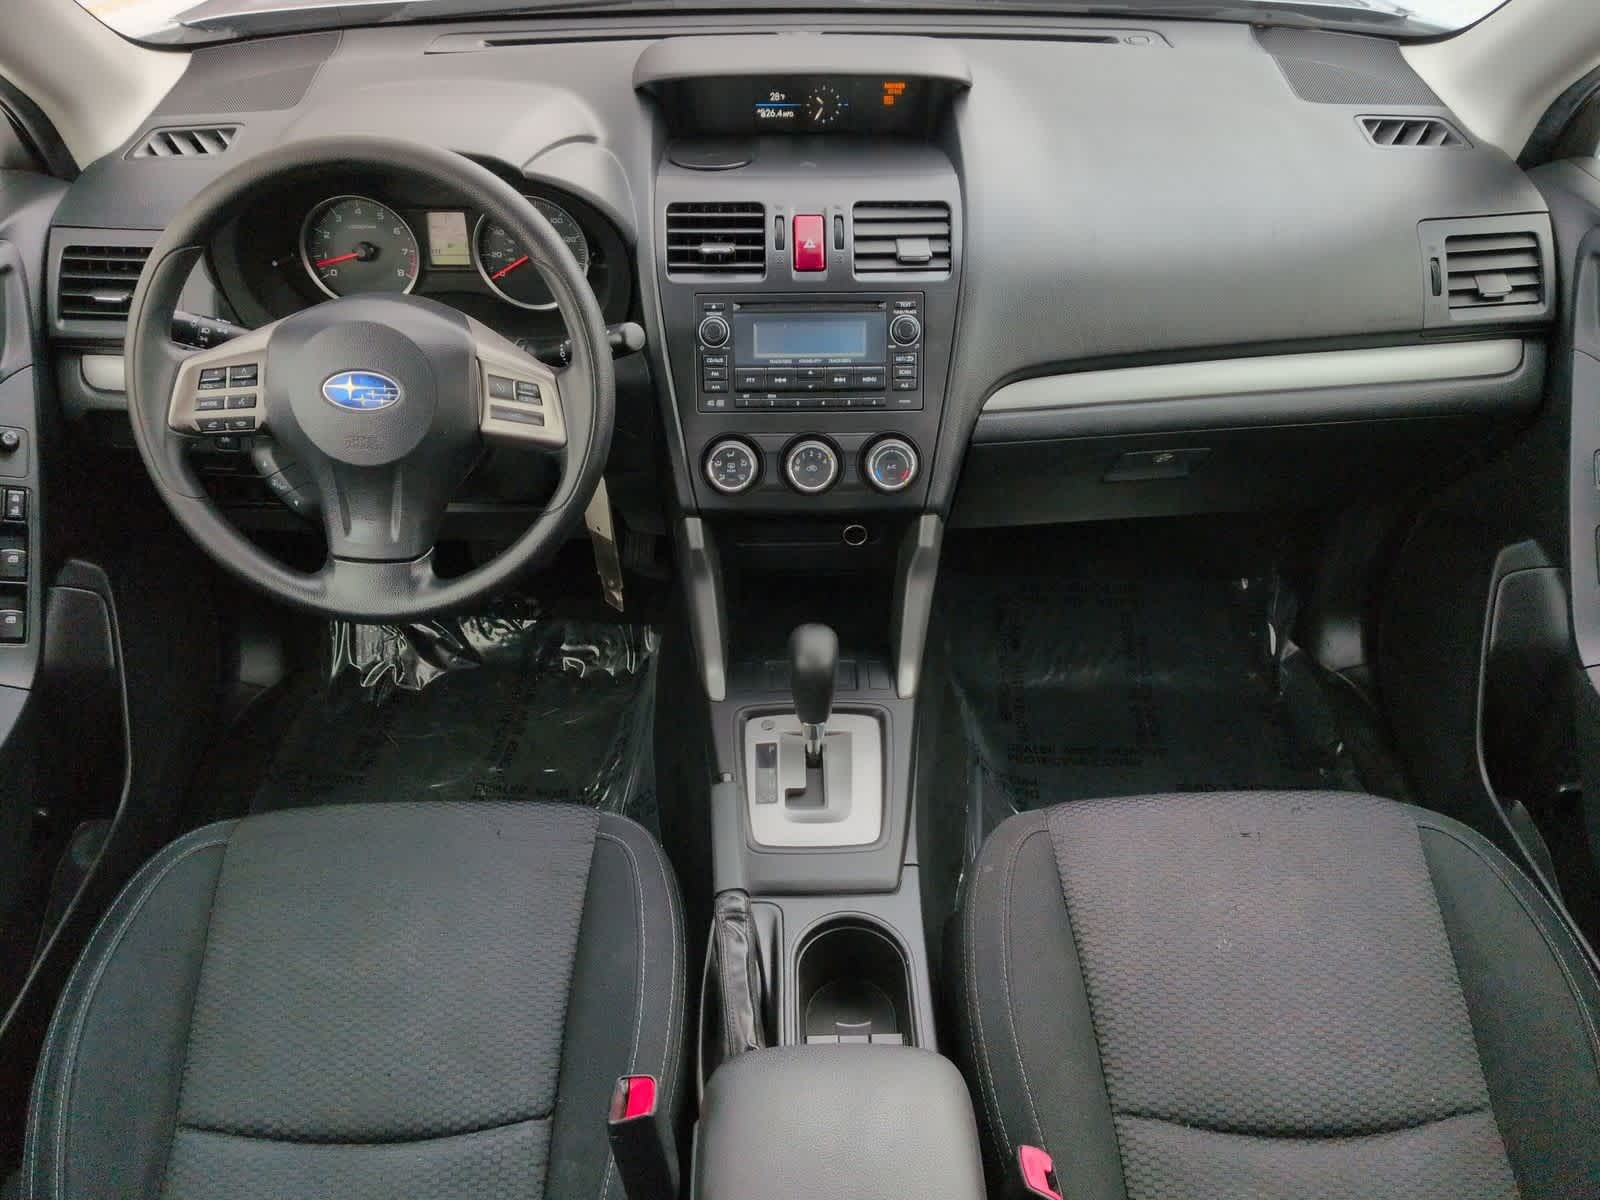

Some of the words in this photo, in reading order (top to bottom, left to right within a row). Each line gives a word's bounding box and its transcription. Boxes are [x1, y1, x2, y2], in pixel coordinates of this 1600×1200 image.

[354, 208, 362, 216] 4
[393, 228, 401, 237] 6
[401, 248, 408, 257] 7
[330, 269, 338, 278] 0
[397, 269, 405, 278] 8
